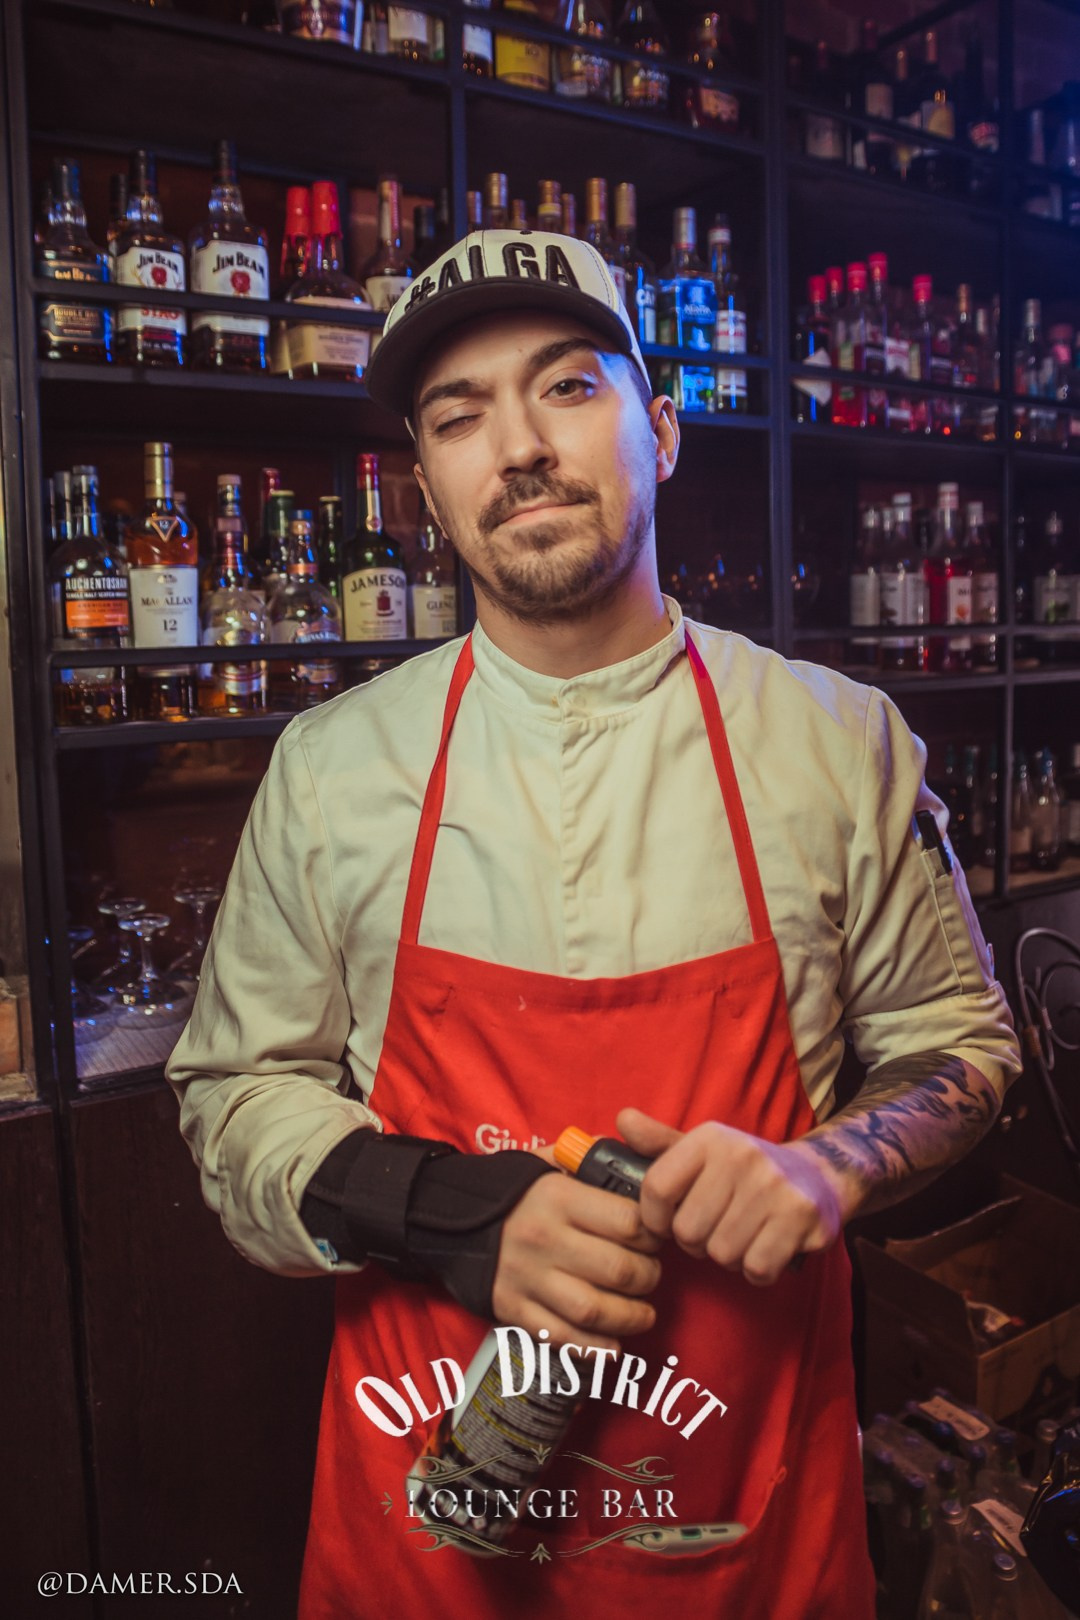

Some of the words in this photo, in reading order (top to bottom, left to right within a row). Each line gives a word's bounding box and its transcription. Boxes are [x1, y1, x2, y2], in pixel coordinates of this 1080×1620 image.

[137, 253, 153, 268] JIM
[213, 254, 234, 273] JIM
[162, 619, 177, 631] 12
